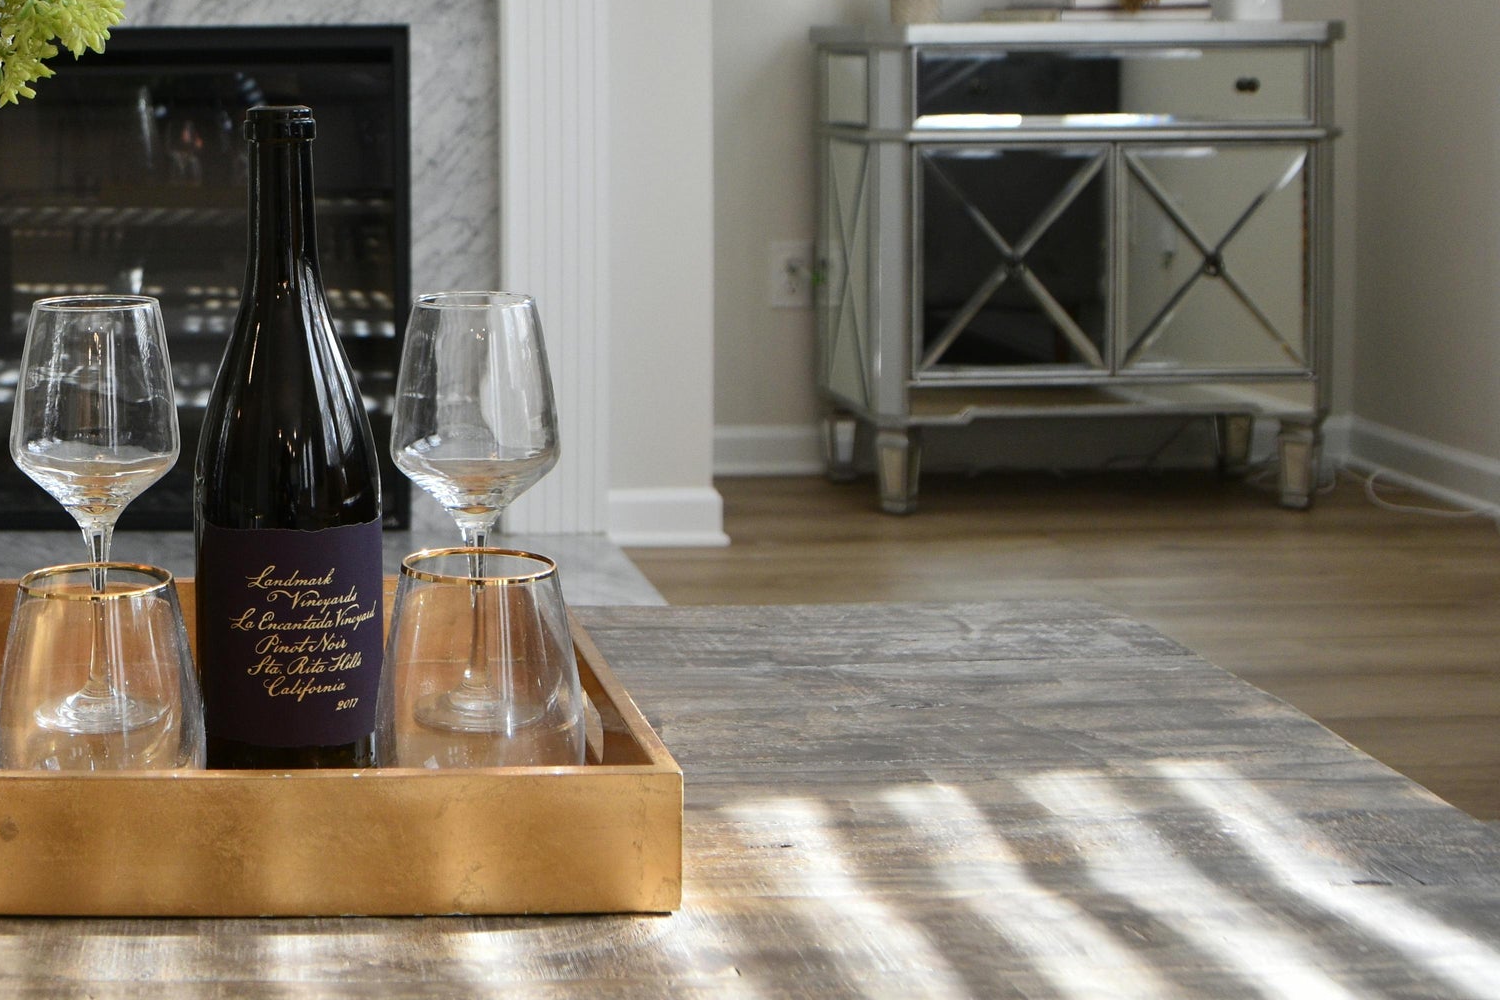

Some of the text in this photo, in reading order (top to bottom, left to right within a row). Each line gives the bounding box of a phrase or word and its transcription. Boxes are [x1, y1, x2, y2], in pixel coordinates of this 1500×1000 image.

[245, 565, 335, 589] Landmark
[267, 585, 357, 613] Vineyards
[229, 600, 377, 631] La Encantada Vineyard
[255, 632, 348, 655] Pinot Noir
[247, 652, 363, 676] Sta. Rita Hills
[263, 676, 346, 702] California
[335, 698, 359, 711] 2017
